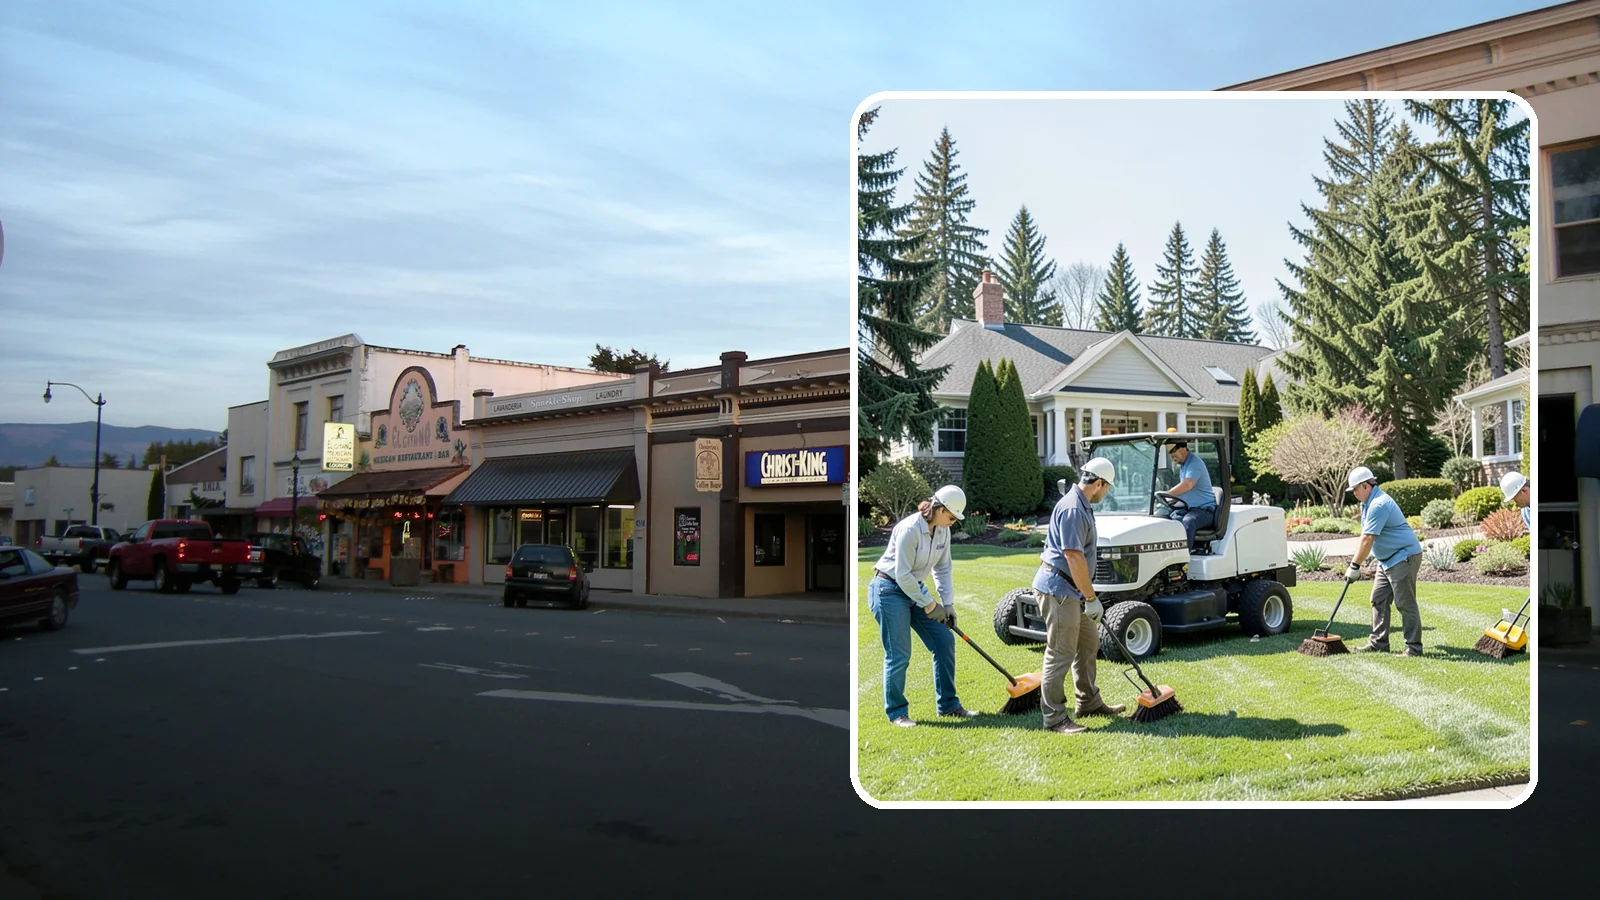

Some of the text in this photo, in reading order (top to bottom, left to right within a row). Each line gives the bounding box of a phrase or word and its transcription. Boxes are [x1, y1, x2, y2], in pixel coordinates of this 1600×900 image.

[493, 389, 623, 412] LAVANDERIA Sparkle Shop LAUNDRY
[373, 454, 396, 464] MEXICAN
[397, 451, 433, 462] RESTAURANT
[437, 450, 450, 459] BAR
[760, 450, 827, 478] CHRIST KING
